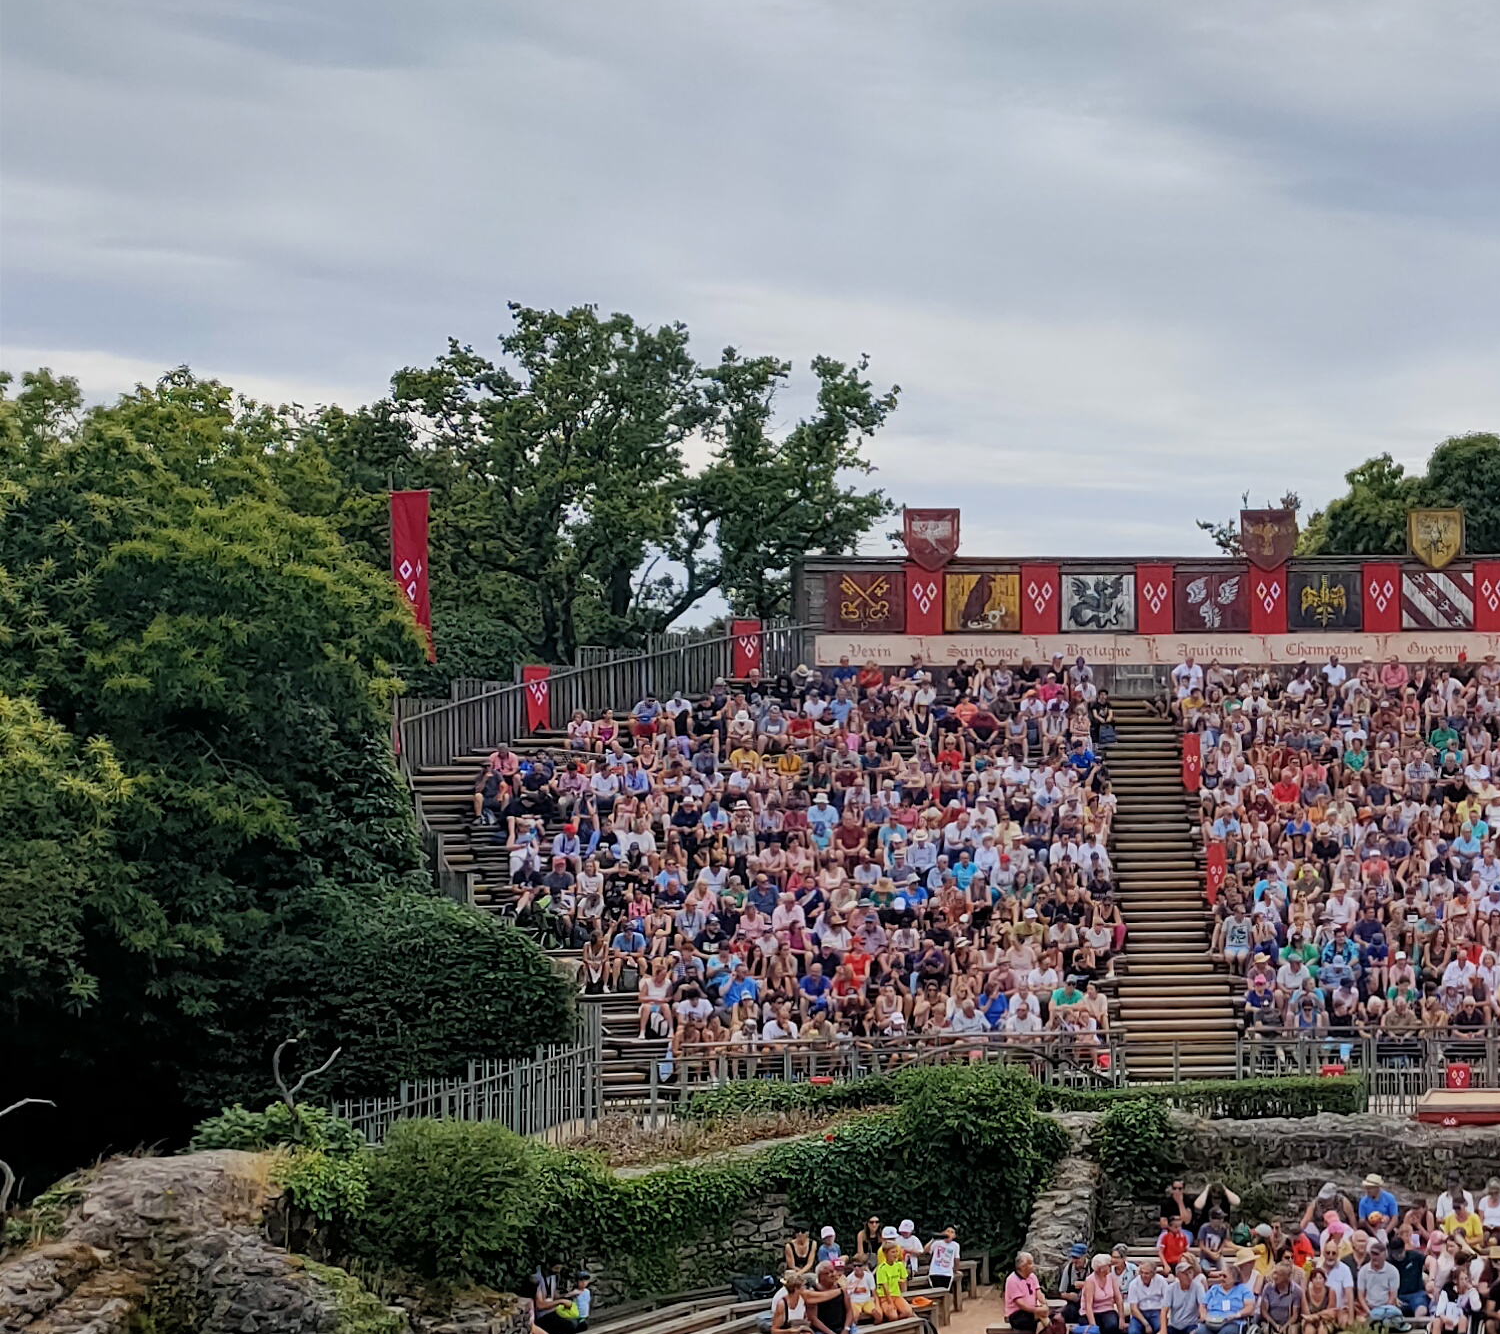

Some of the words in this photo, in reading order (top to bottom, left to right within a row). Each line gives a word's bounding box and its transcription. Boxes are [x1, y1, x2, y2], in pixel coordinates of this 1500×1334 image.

[848, 643, 892, 658] Vexin
[946, 643, 1020, 661] Saintonge
[1065, 643, 1132, 660] Bretagne
[1177, 642, 1244, 658] Aquitaine
[1285, 641, 1364, 659] Champagne
